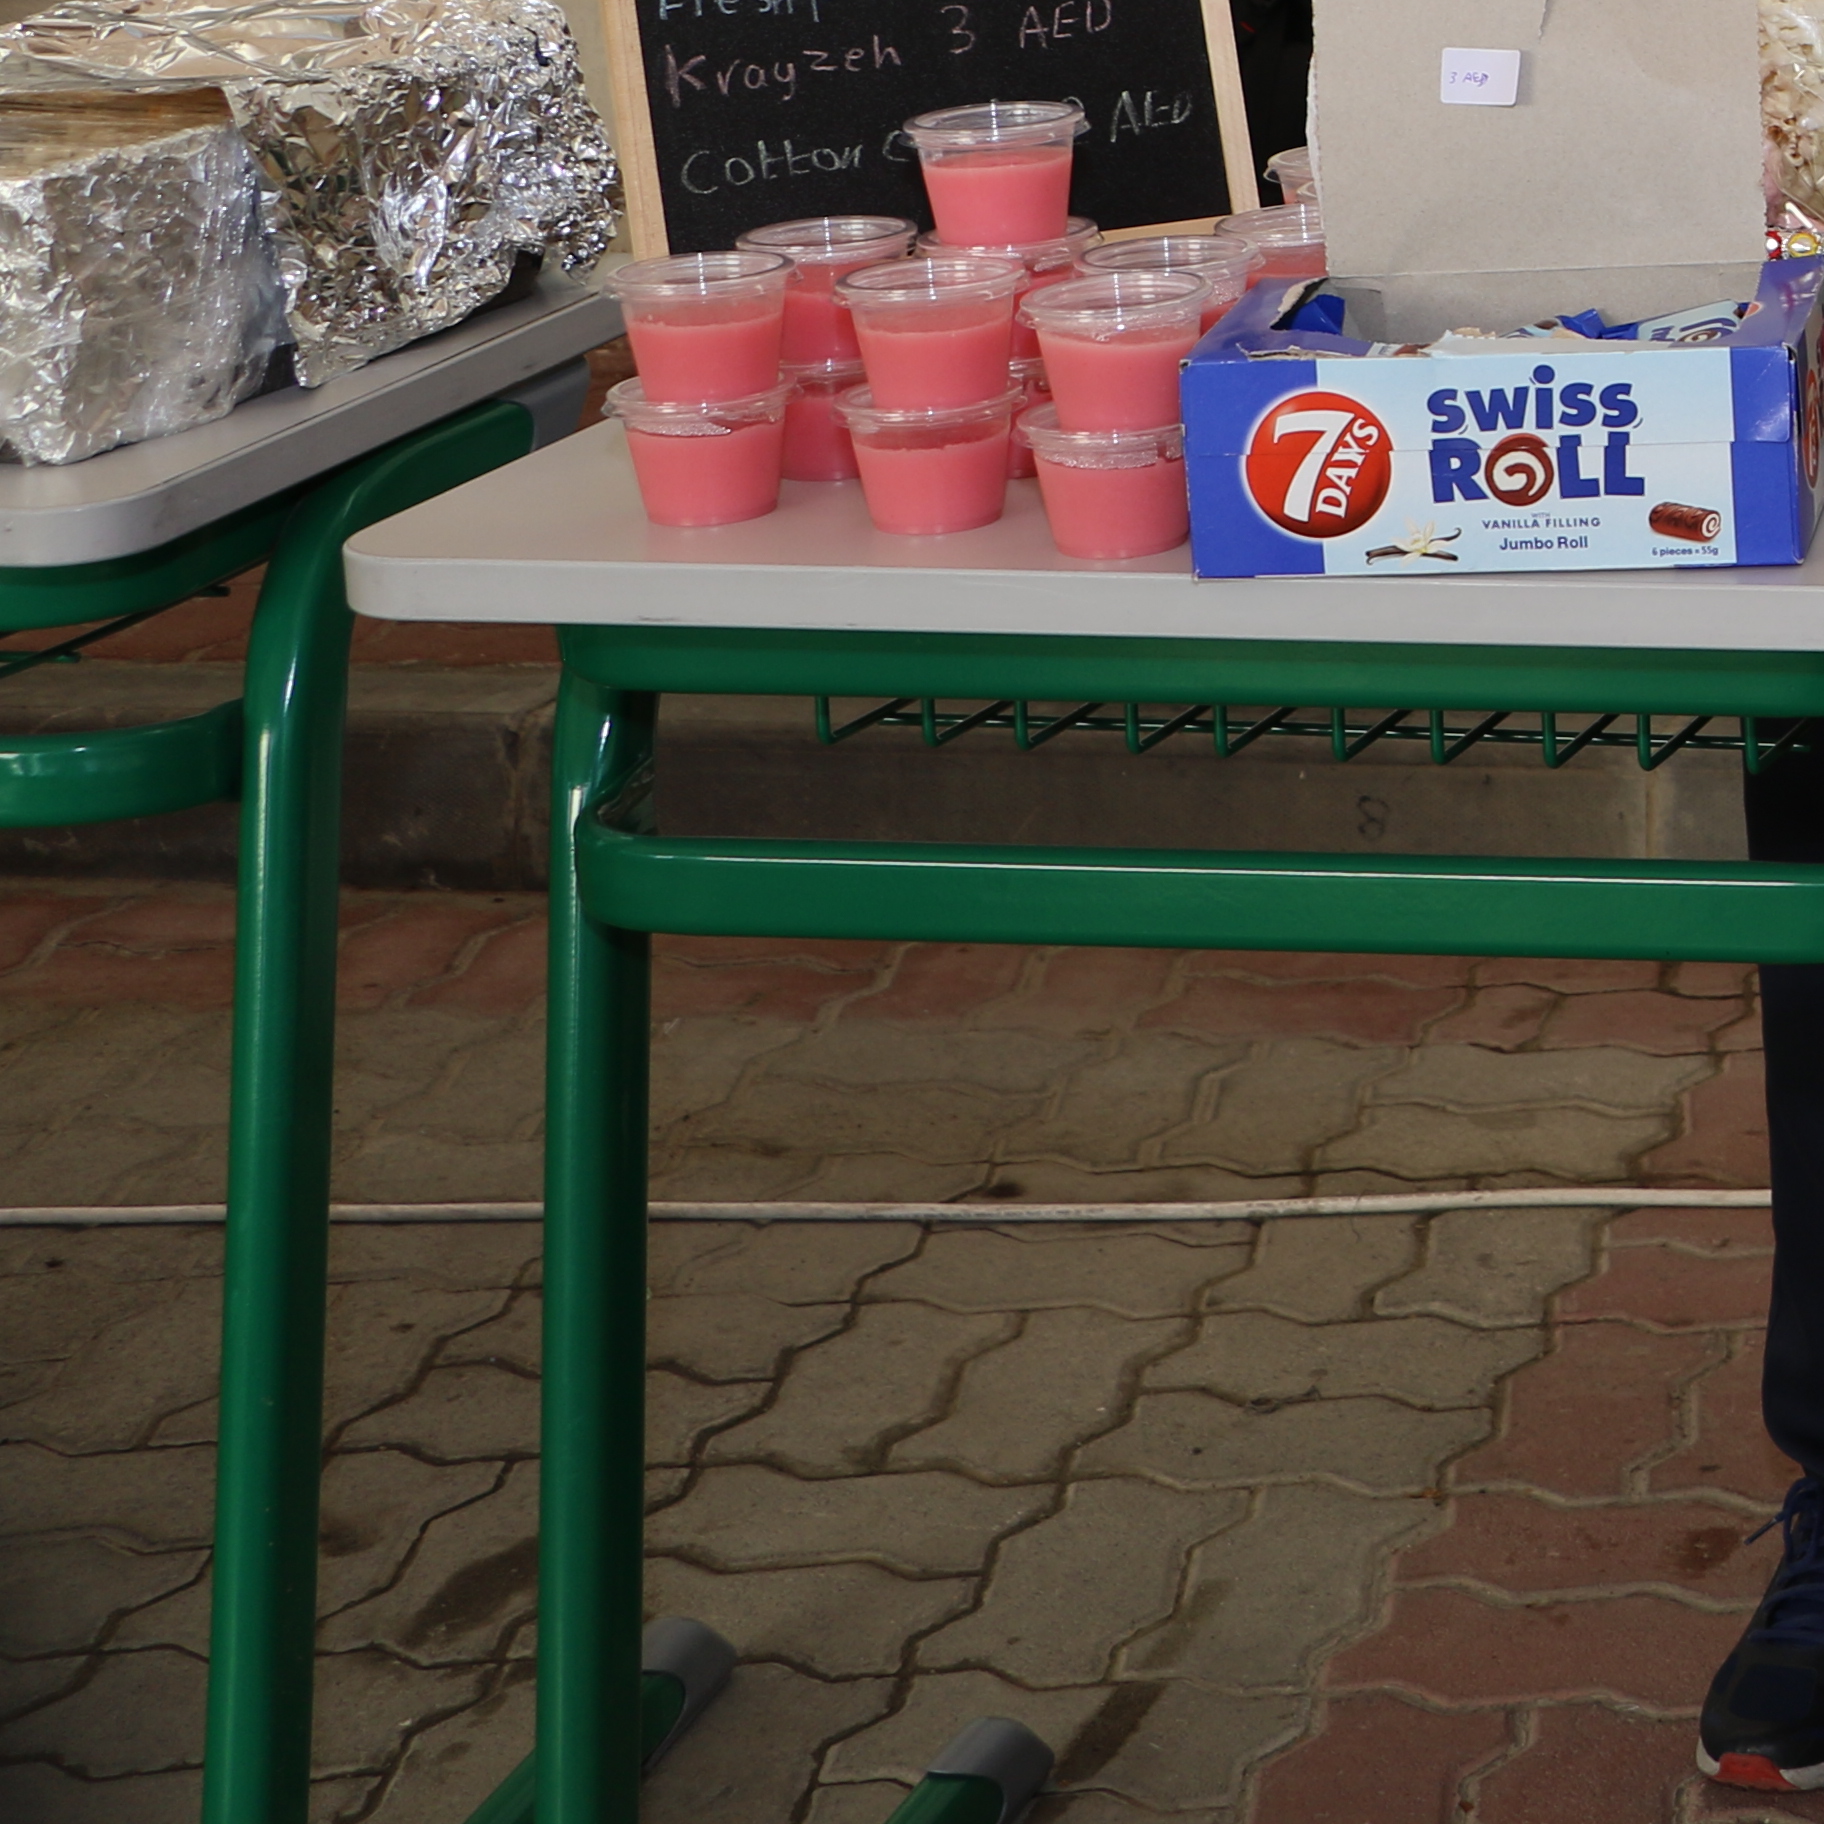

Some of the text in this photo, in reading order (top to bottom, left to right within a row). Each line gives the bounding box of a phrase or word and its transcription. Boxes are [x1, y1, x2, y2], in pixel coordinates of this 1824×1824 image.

[940, 4, 977, 55] 3
[680, 138, 866, 196] Cotton
[1108, 90, 1193, 143] AED
[1272, 409, 1357, 524] 7
[1315, 417, 1380, 519] DAYS
[1481, 517, 1601, 531] VANILLA FILLING
[1499, 534, 1589, 552] Jumbo Roll
